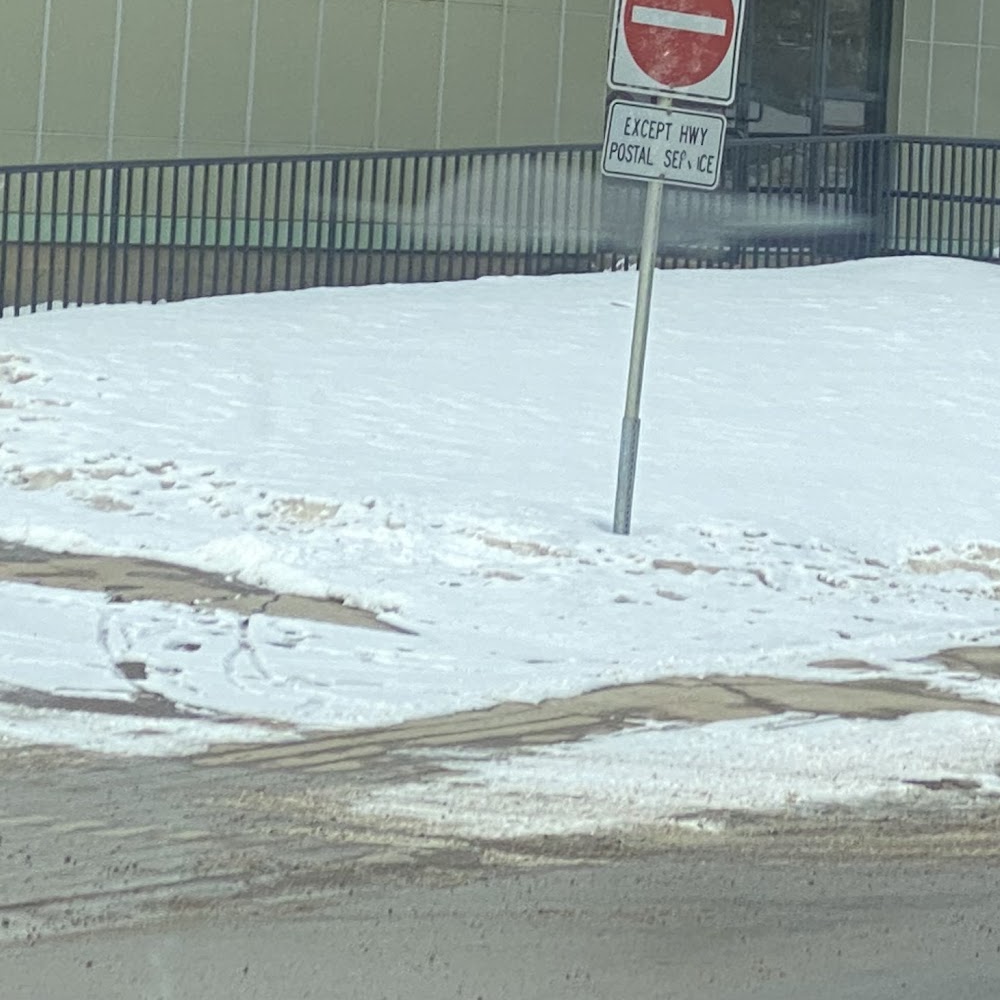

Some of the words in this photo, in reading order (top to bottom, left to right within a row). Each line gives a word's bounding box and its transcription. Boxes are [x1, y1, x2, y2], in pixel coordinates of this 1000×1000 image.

[623, 117, 673, 140] EXCEPT
[680, 125, 708, 146] HWY
[609, 142, 654, 166] POSTAL
